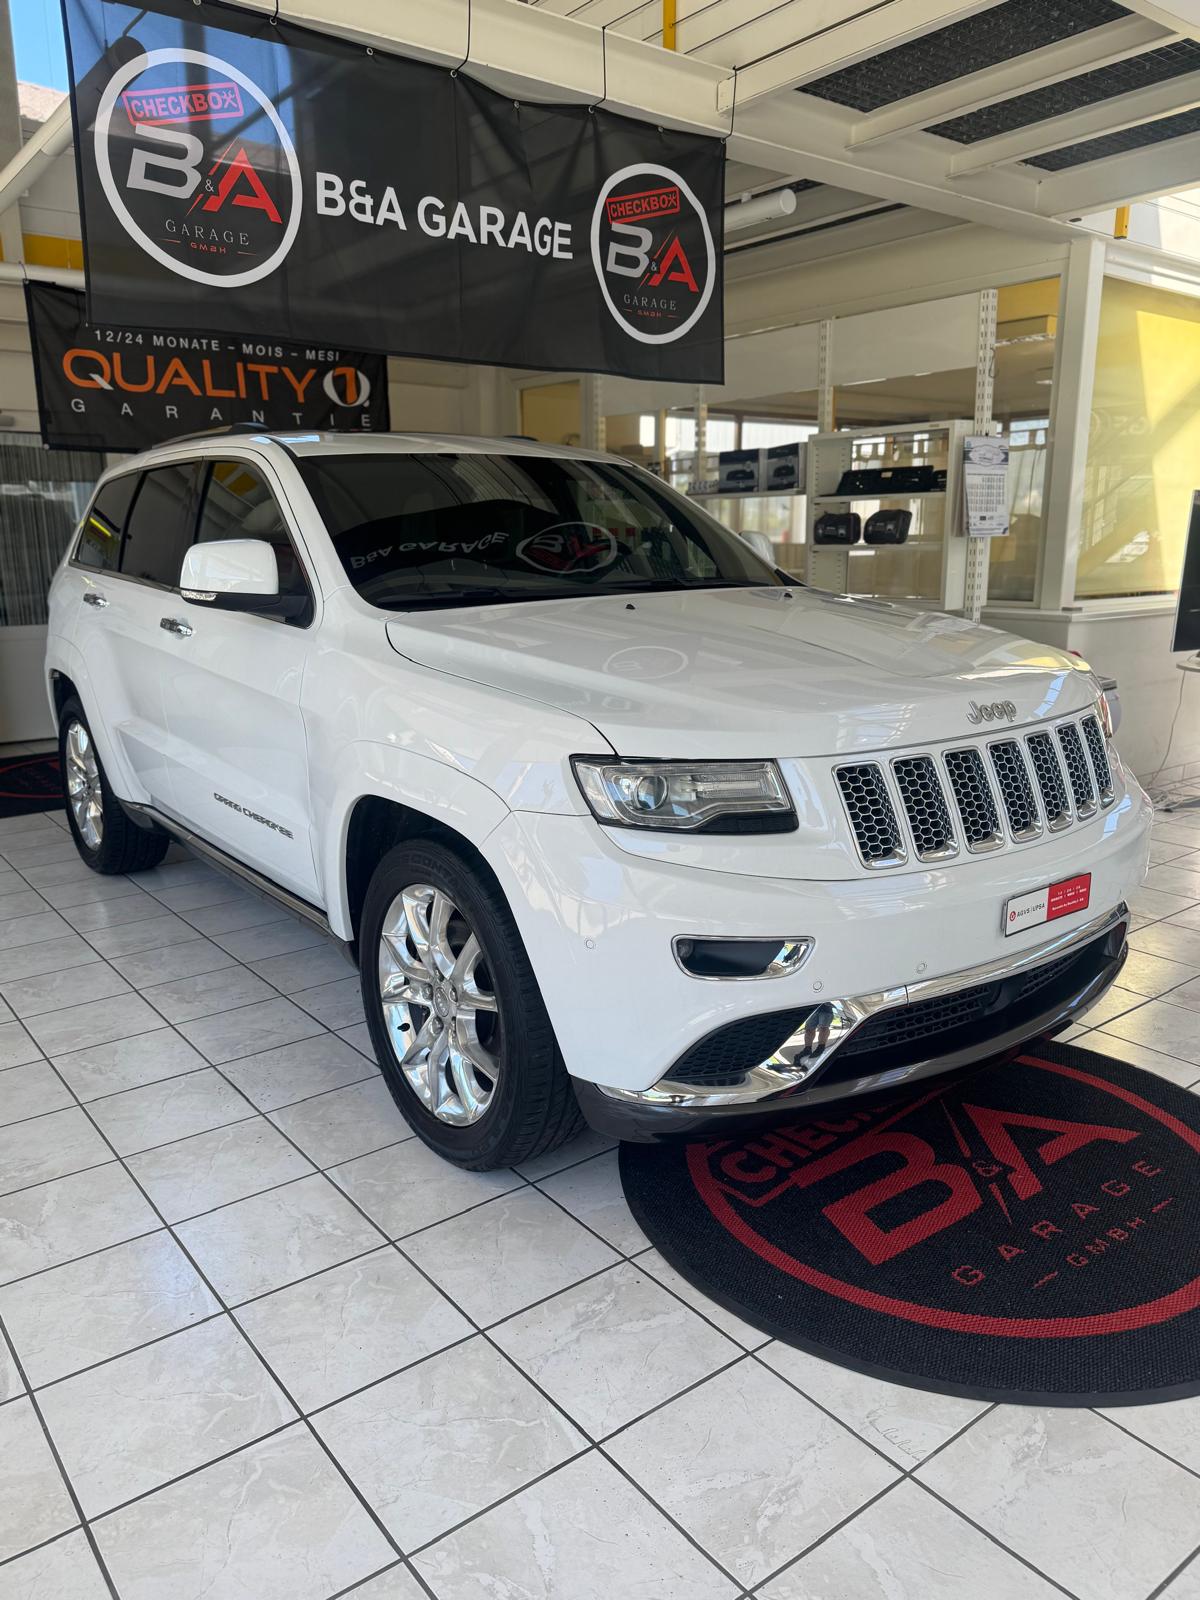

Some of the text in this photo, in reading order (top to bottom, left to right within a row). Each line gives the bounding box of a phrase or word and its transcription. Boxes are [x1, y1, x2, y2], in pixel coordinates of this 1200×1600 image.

[316, 171, 573, 259] B&A GARAGE
[165, 219, 250, 246] GARAGE
[623, 294, 677, 311] GARAGE
[94, 329, 143, 345] 12/24
[153, 335, 220, 351] MONATE
[242, 343, 283, 358] MOIS
[306, 349, 340, 362] MESI
[63, 348, 317, 404] QUALITY
[71, 398, 371, 427] GARANTIE
[966, 700, 1017, 725] Jeep
[951, 1160, 1164, 1285] GARAGE
[1065, 1216, 1147, 1268] GMBH
